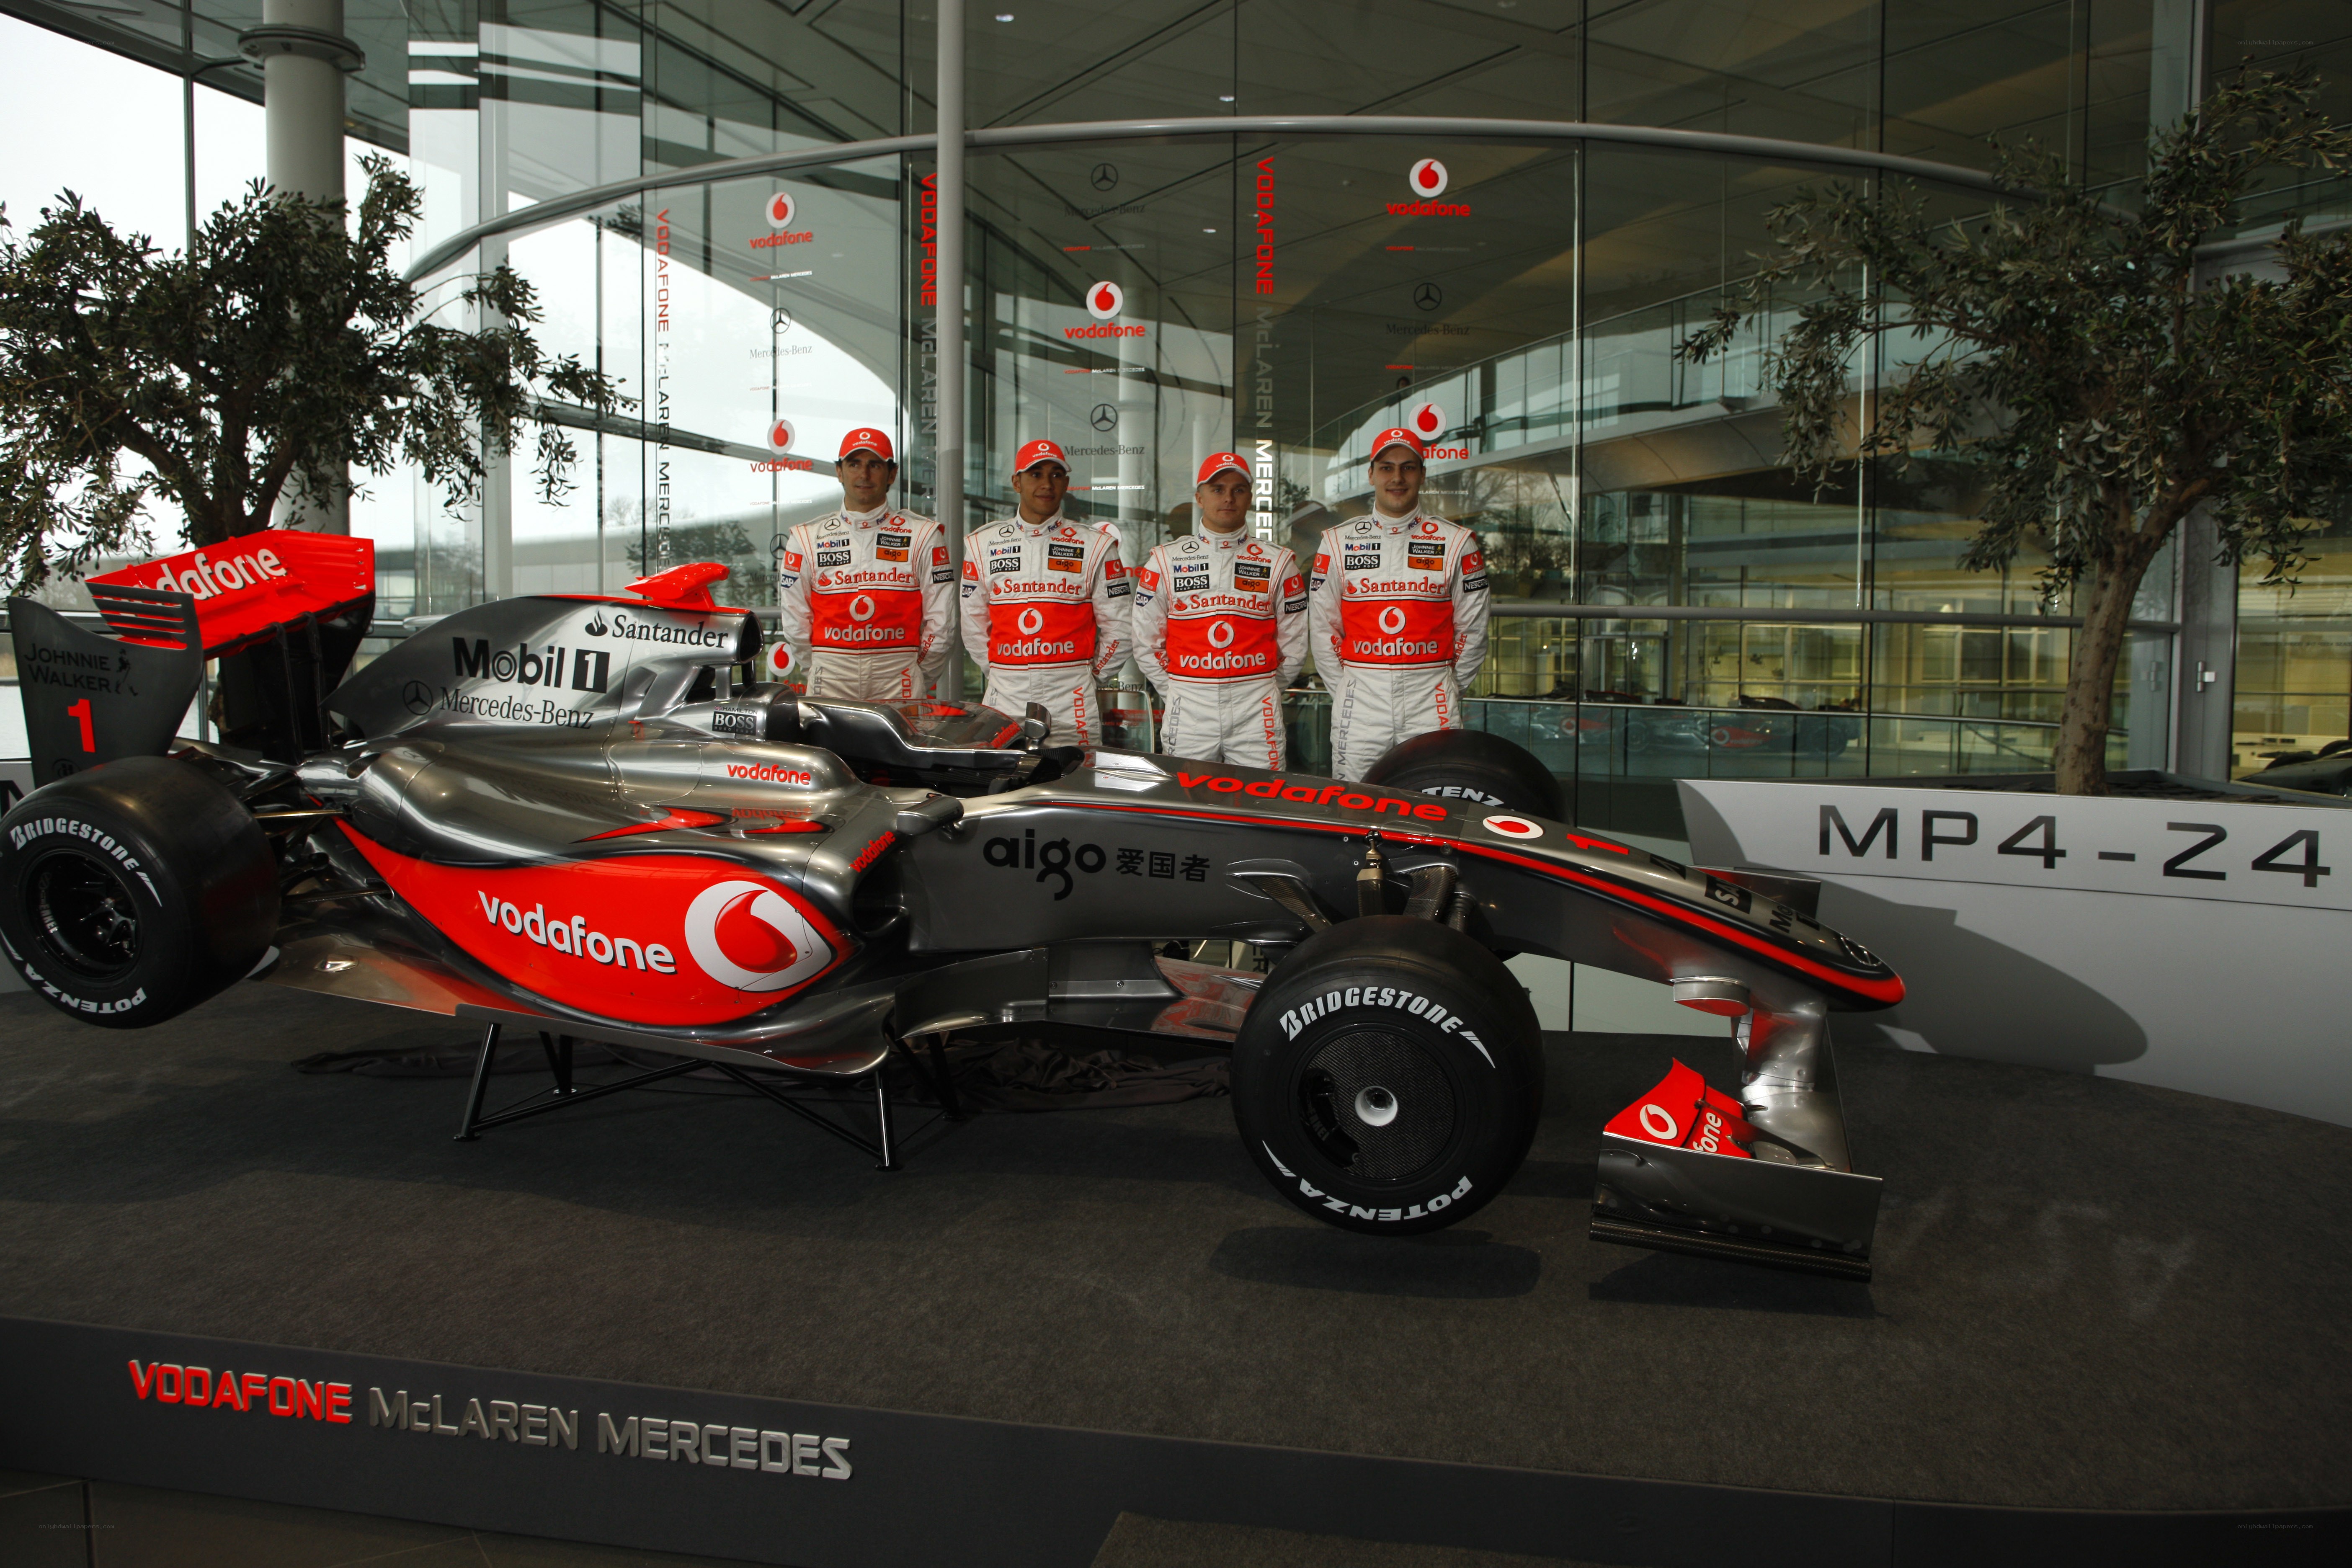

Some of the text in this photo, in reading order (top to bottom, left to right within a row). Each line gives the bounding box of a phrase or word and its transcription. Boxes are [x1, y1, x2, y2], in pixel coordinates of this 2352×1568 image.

[1386, 200, 1471, 217] vodafone
[750, 230, 812, 248] vodafone
[922, 173, 936, 306] VODAFONE
[657, 209, 668, 332] VODAFONE
[1064, 322, 1145, 338] vodafone
[1386, 324, 1470, 335] Mercedes-Benz
[1256, 157, 1274, 541] VODAFONE McLAREN MERCED
[1064, 445, 1145, 456] Mercedes-Benz
[1423, 444, 1469, 459] afone
[750, 457, 813, 472] vodafone
[659, 462, 670, 567] MERCEDE
[818, 540, 841, 549] Mobil
[990, 547, 1011, 557] Mobil
[819, 552, 849, 562] BOSS
[884, 549, 901, 560] aigo
[991, 558, 1019, 569] BOSS
[1237, 554, 1271, 564] vodafone
[1347, 555, 1378, 565] BOSS
[1416, 558, 1434, 569] aigo
[1056, 560, 1073, 570] aigo
[1174, 564, 1199, 573] Mobil
[156, 549, 286, 601] dafone
[781, 576, 794, 586] SAP
[835, 567, 913, 585] Santander
[1176, 577, 1207, 588] BOSS
[962, 585, 972, 597] SAP
[1003, 578, 1082, 595] Santander
[1243, 579, 1260, 591] aigo
[1360, 577, 1445, 594] Santander
[1136, 594, 1148, 605] SAP
[1190, 594, 1270, 611] Santander
[612, 614, 729, 648] Santander
[825, 624, 905, 642] vodafone
[997, 638, 1074, 657] vodafone
[1353, 638, 1438, 656] vodafone
[24, 643, 109, 671] JOHNNIE
[453, 637, 565, 688] Mobil
[1180, 651, 1266, 669] vodafone
[28, 665, 111, 693] WALKER
[440, 686, 594, 730] Mercedes-Benz
[1435, 682, 1449, 730] VODA
[715, 713, 754, 729] BOSS
[1073, 687, 1089, 745] VODAF
[1338, 679, 1357, 766] MERCEDES
[68, 699, 95, 753] 1
[1262, 696, 1279, 771] VODAFON
[727, 763, 811, 784] vodafone
[1177, 772, 1447, 821] vodafone
[1422, 787, 1504, 807] TENZ
[10, 818, 139, 871] BRIDGESTONE
[849, 831, 895, 873] vodafone
[1567, 833, 1629, 855] 1
[1819, 804, 2331, 888] MP4-24
[983, 829, 1106, 901] aigo
[1116, 848, 1210, 882] 爱国者
[1715, 880, 1741, 906] SA
[478, 890, 676, 973] vodafone
[25, 963, 147, 1014] POTENZA
[1279, 987, 1463, 1042] BRIDGESTONE
[1693, 1112, 1722, 1153] fone
[1300, 1175, 1473, 1221] POTENZA
[128, 1359, 851, 1480] VODAFONE McLAREN MERCEDES
